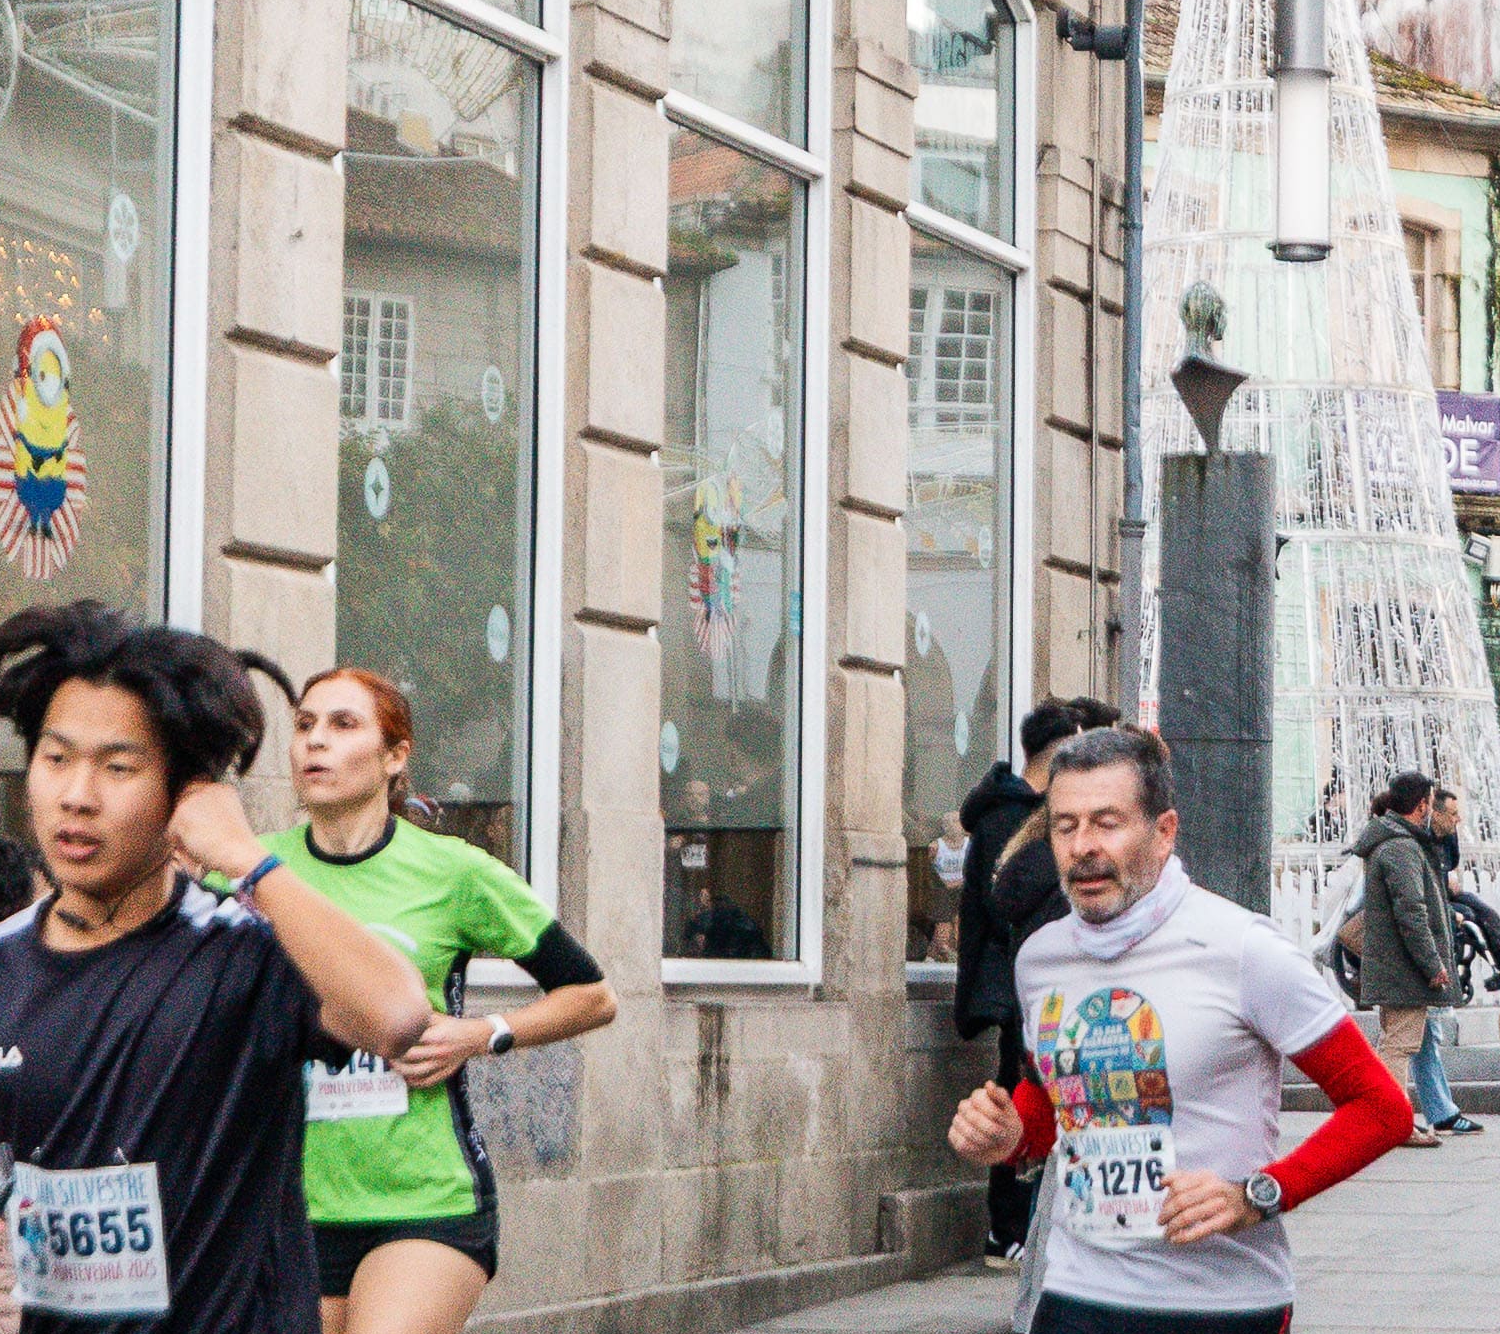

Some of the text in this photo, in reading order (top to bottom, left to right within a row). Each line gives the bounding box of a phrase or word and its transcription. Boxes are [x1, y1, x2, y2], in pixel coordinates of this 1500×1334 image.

[1441, 413, 1496, 436] Malvar
[57, 1171, 149, 1207] SILVESTRE
[1098, 1156, 1167, 1196] 1276
[46, 1203, 154, 1257] 5655
